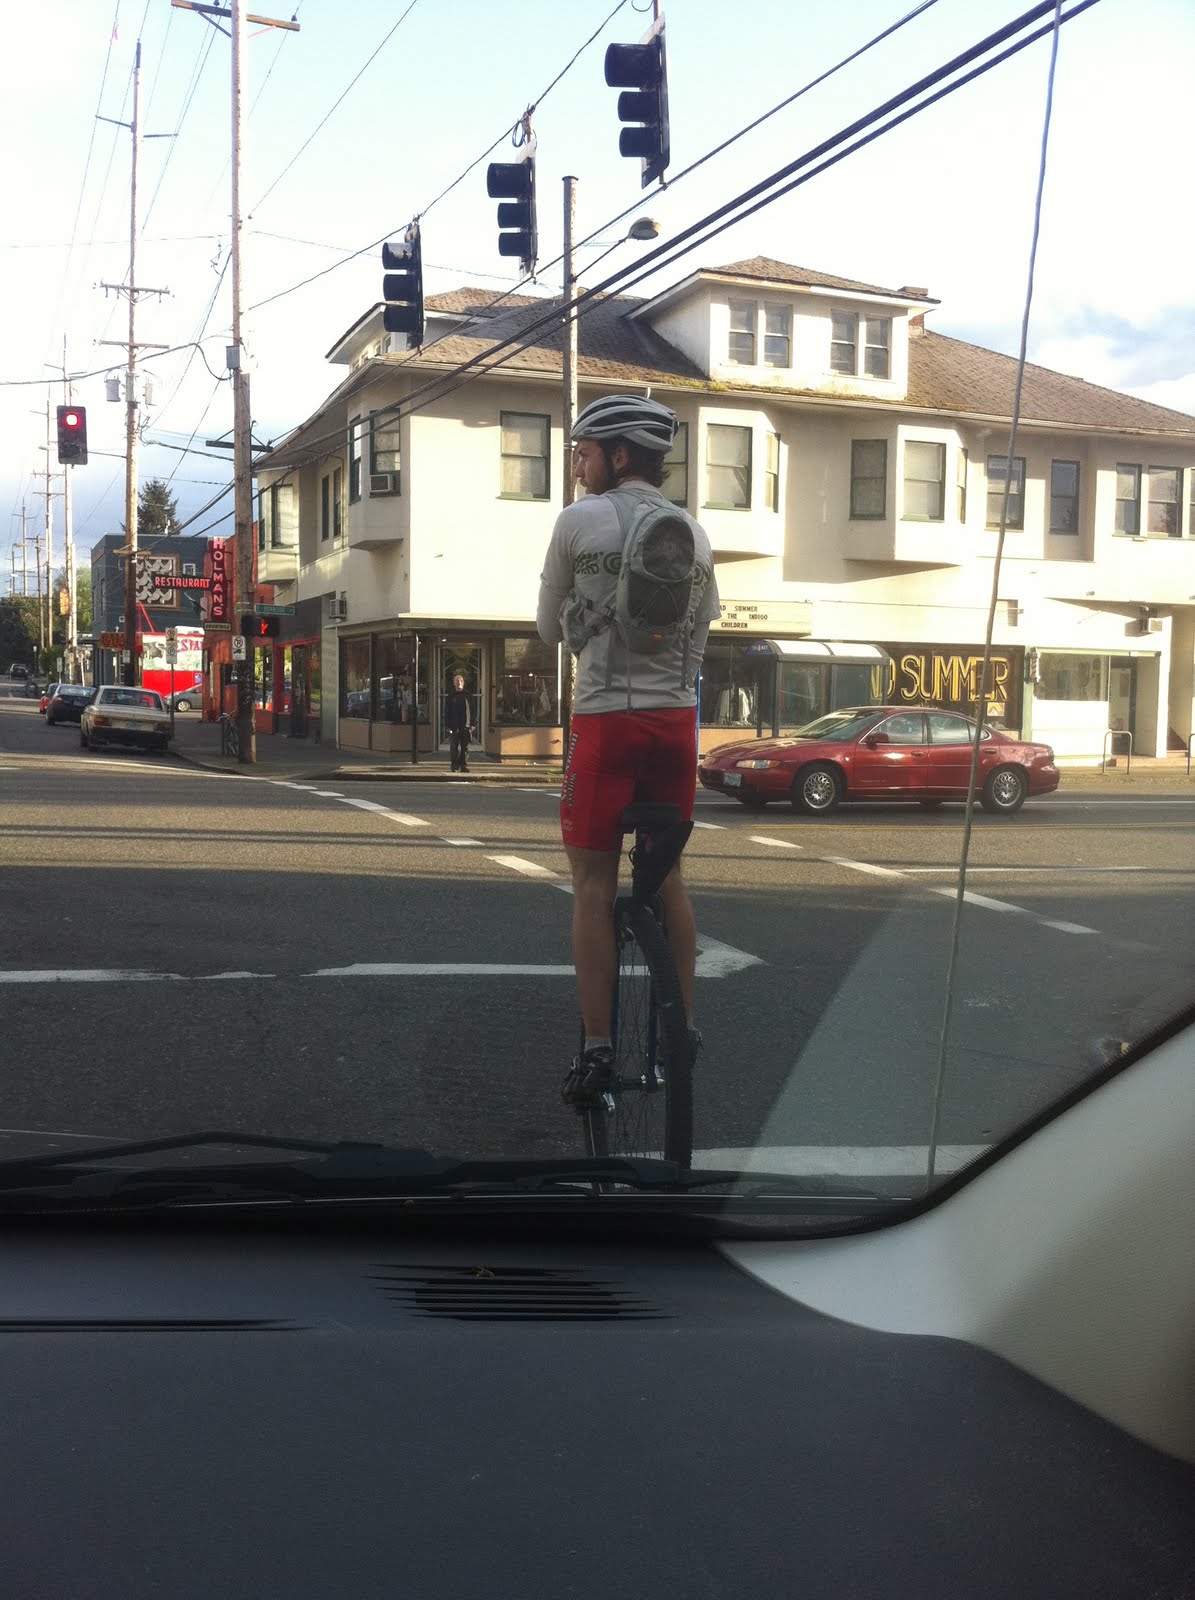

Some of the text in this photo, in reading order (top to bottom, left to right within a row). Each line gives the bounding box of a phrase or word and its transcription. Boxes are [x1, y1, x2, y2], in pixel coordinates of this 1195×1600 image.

[154, 576, 211, 589] RESTAURANT
[213, 536, 224, 616] HOLMAN'S
[727, 612, 769, 621] THE INDIGO
[720, 621, 748, 629] CHILDREN
[901, 654, 1009, 701] SUMMER
